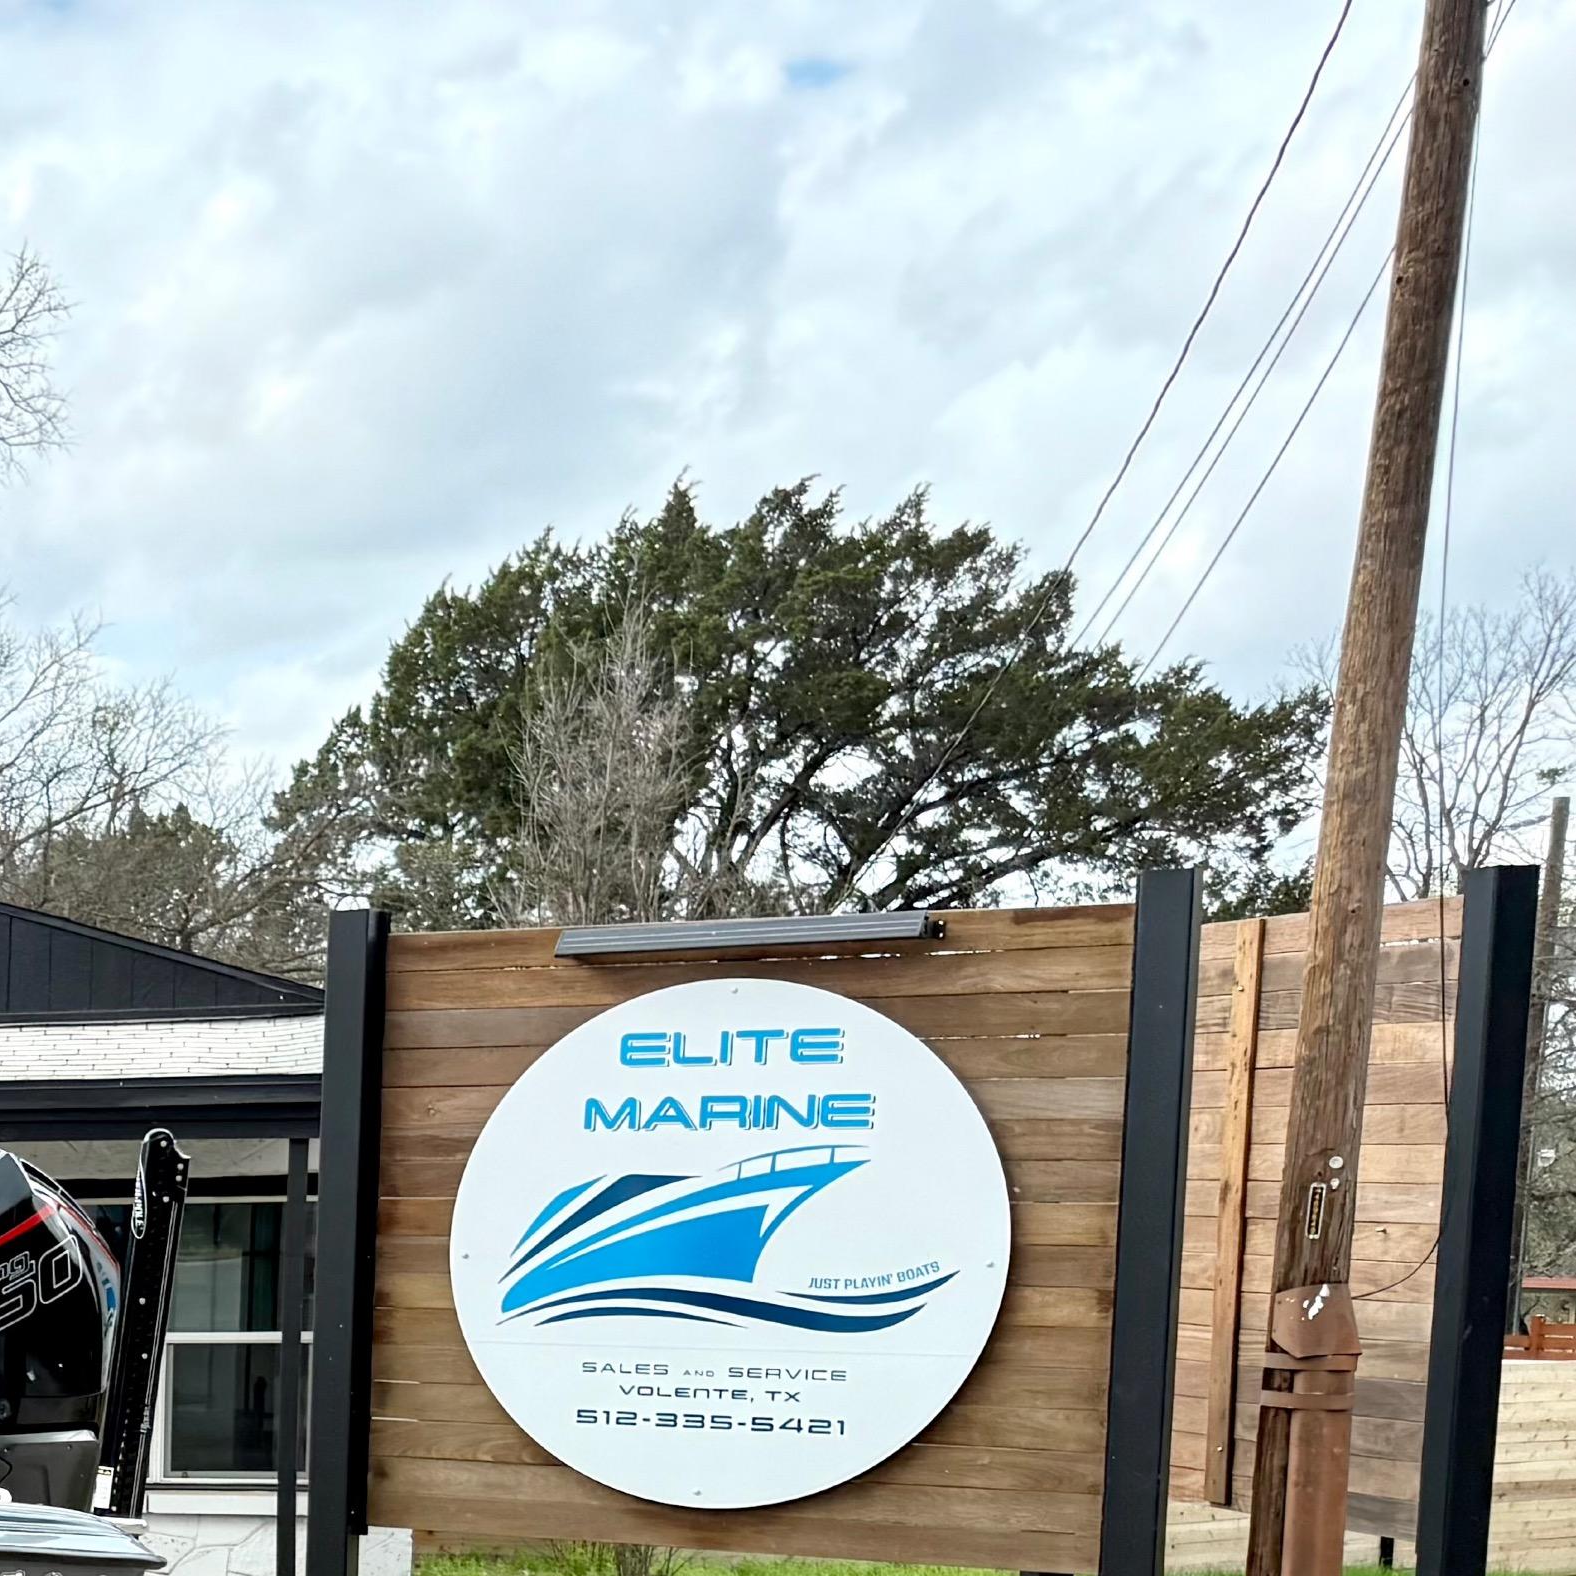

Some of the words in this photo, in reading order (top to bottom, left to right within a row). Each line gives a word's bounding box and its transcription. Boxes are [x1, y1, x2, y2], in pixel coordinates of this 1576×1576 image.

[619, 1028, 845, 1067] ELITE
[583, 1093, 876, 1131] MARINE
[808, 1277, 841, 1290] JUST
[844, 1273, 893, 1290] PLAYIN'
[897, 1261, 941, 1283] BOATS
[582, 1361, 669, 1375] SALES
[683, 1369, 715, 1377] AND
[728, 1367, 847, 1381] SERVICE
[619, 1385, 754, 1403] VOLENTE,
[765, 1390, 801, 1402] TX
[576, 1408, 845, 1436] 512-335-5421
